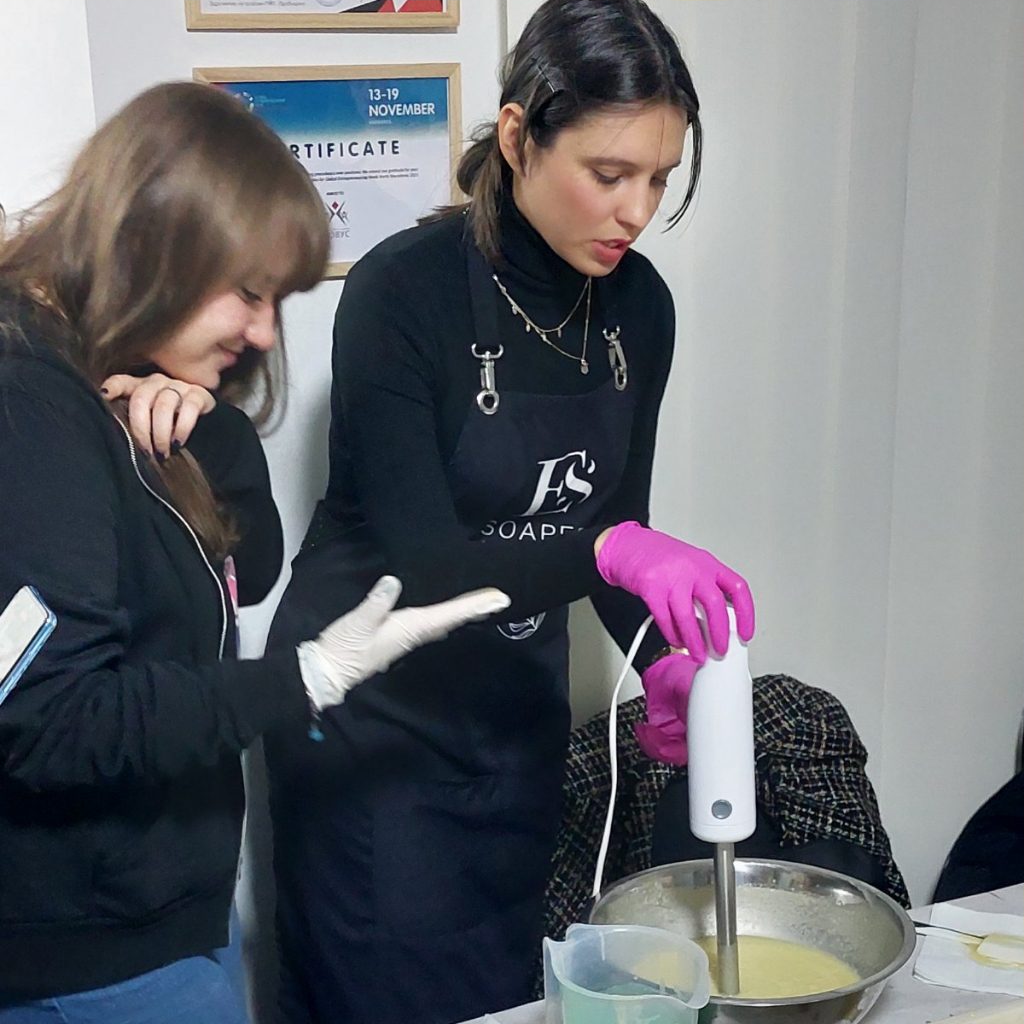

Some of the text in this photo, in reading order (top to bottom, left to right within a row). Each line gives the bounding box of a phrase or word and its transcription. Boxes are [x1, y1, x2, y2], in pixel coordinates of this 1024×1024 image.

[368, 88, 399, 101] 13-19
[368, 103, 435, 117] NOVEMBER
[289, 140, 400, 159] RTIFICATE
